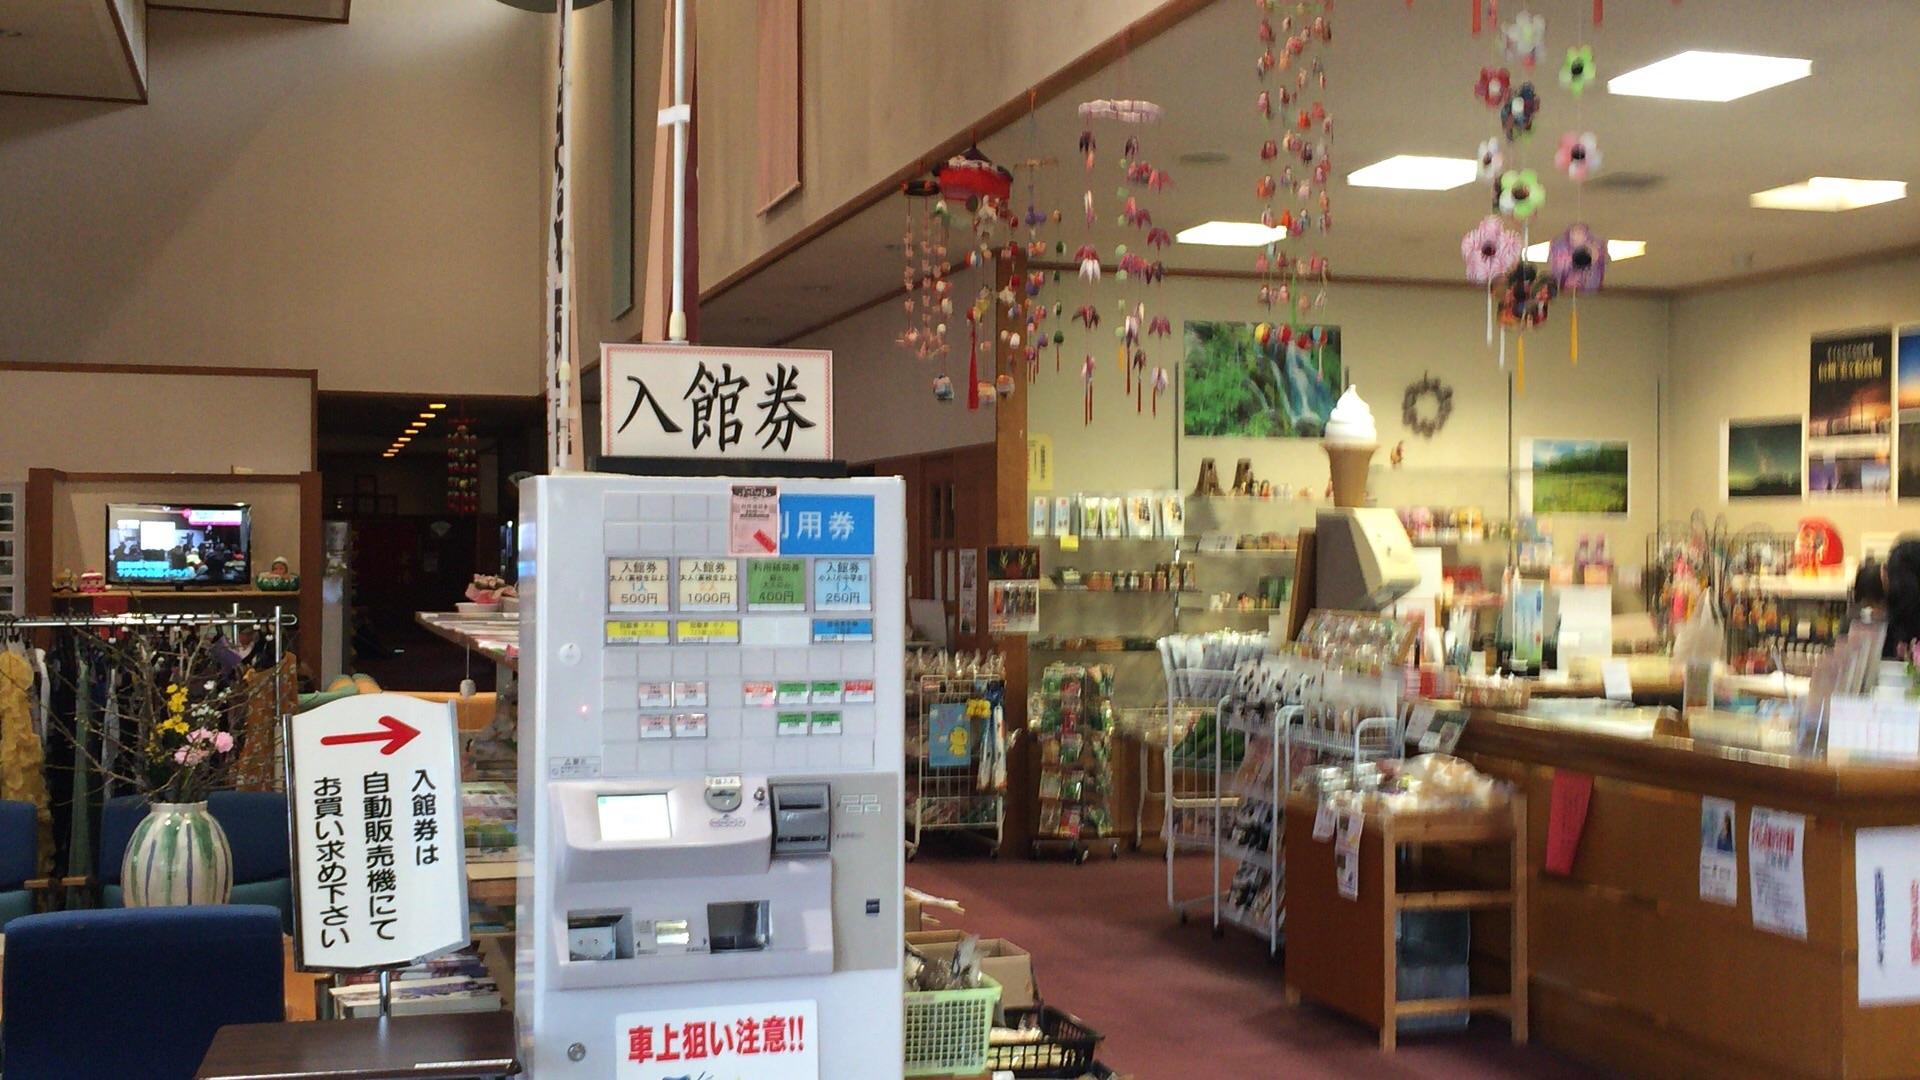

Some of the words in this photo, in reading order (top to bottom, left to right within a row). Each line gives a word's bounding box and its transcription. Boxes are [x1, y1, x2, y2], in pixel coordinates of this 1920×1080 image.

[618, 361, 816, 452] 入館券
[780, 510, 855, 541] 用券
[622, 561, 657, 573] 入館券
[691, 561, 726, 573] 入館券
[827, 561, 860, 573] 入館券
[621, 592, 658, 605] 500円
[688, 592, 731, 605] 1000円
[759, 590, 794, 603] 400円
[826, 591, 860, 604] 250円
[412, 769, 439, 866] 入館券は
[363, 771, 398, 940] 自動販売機にて
[314, 776, 350, 949] お買い求め下さい
[628, 1015, 804, 1064] 車上狙い注意!!
